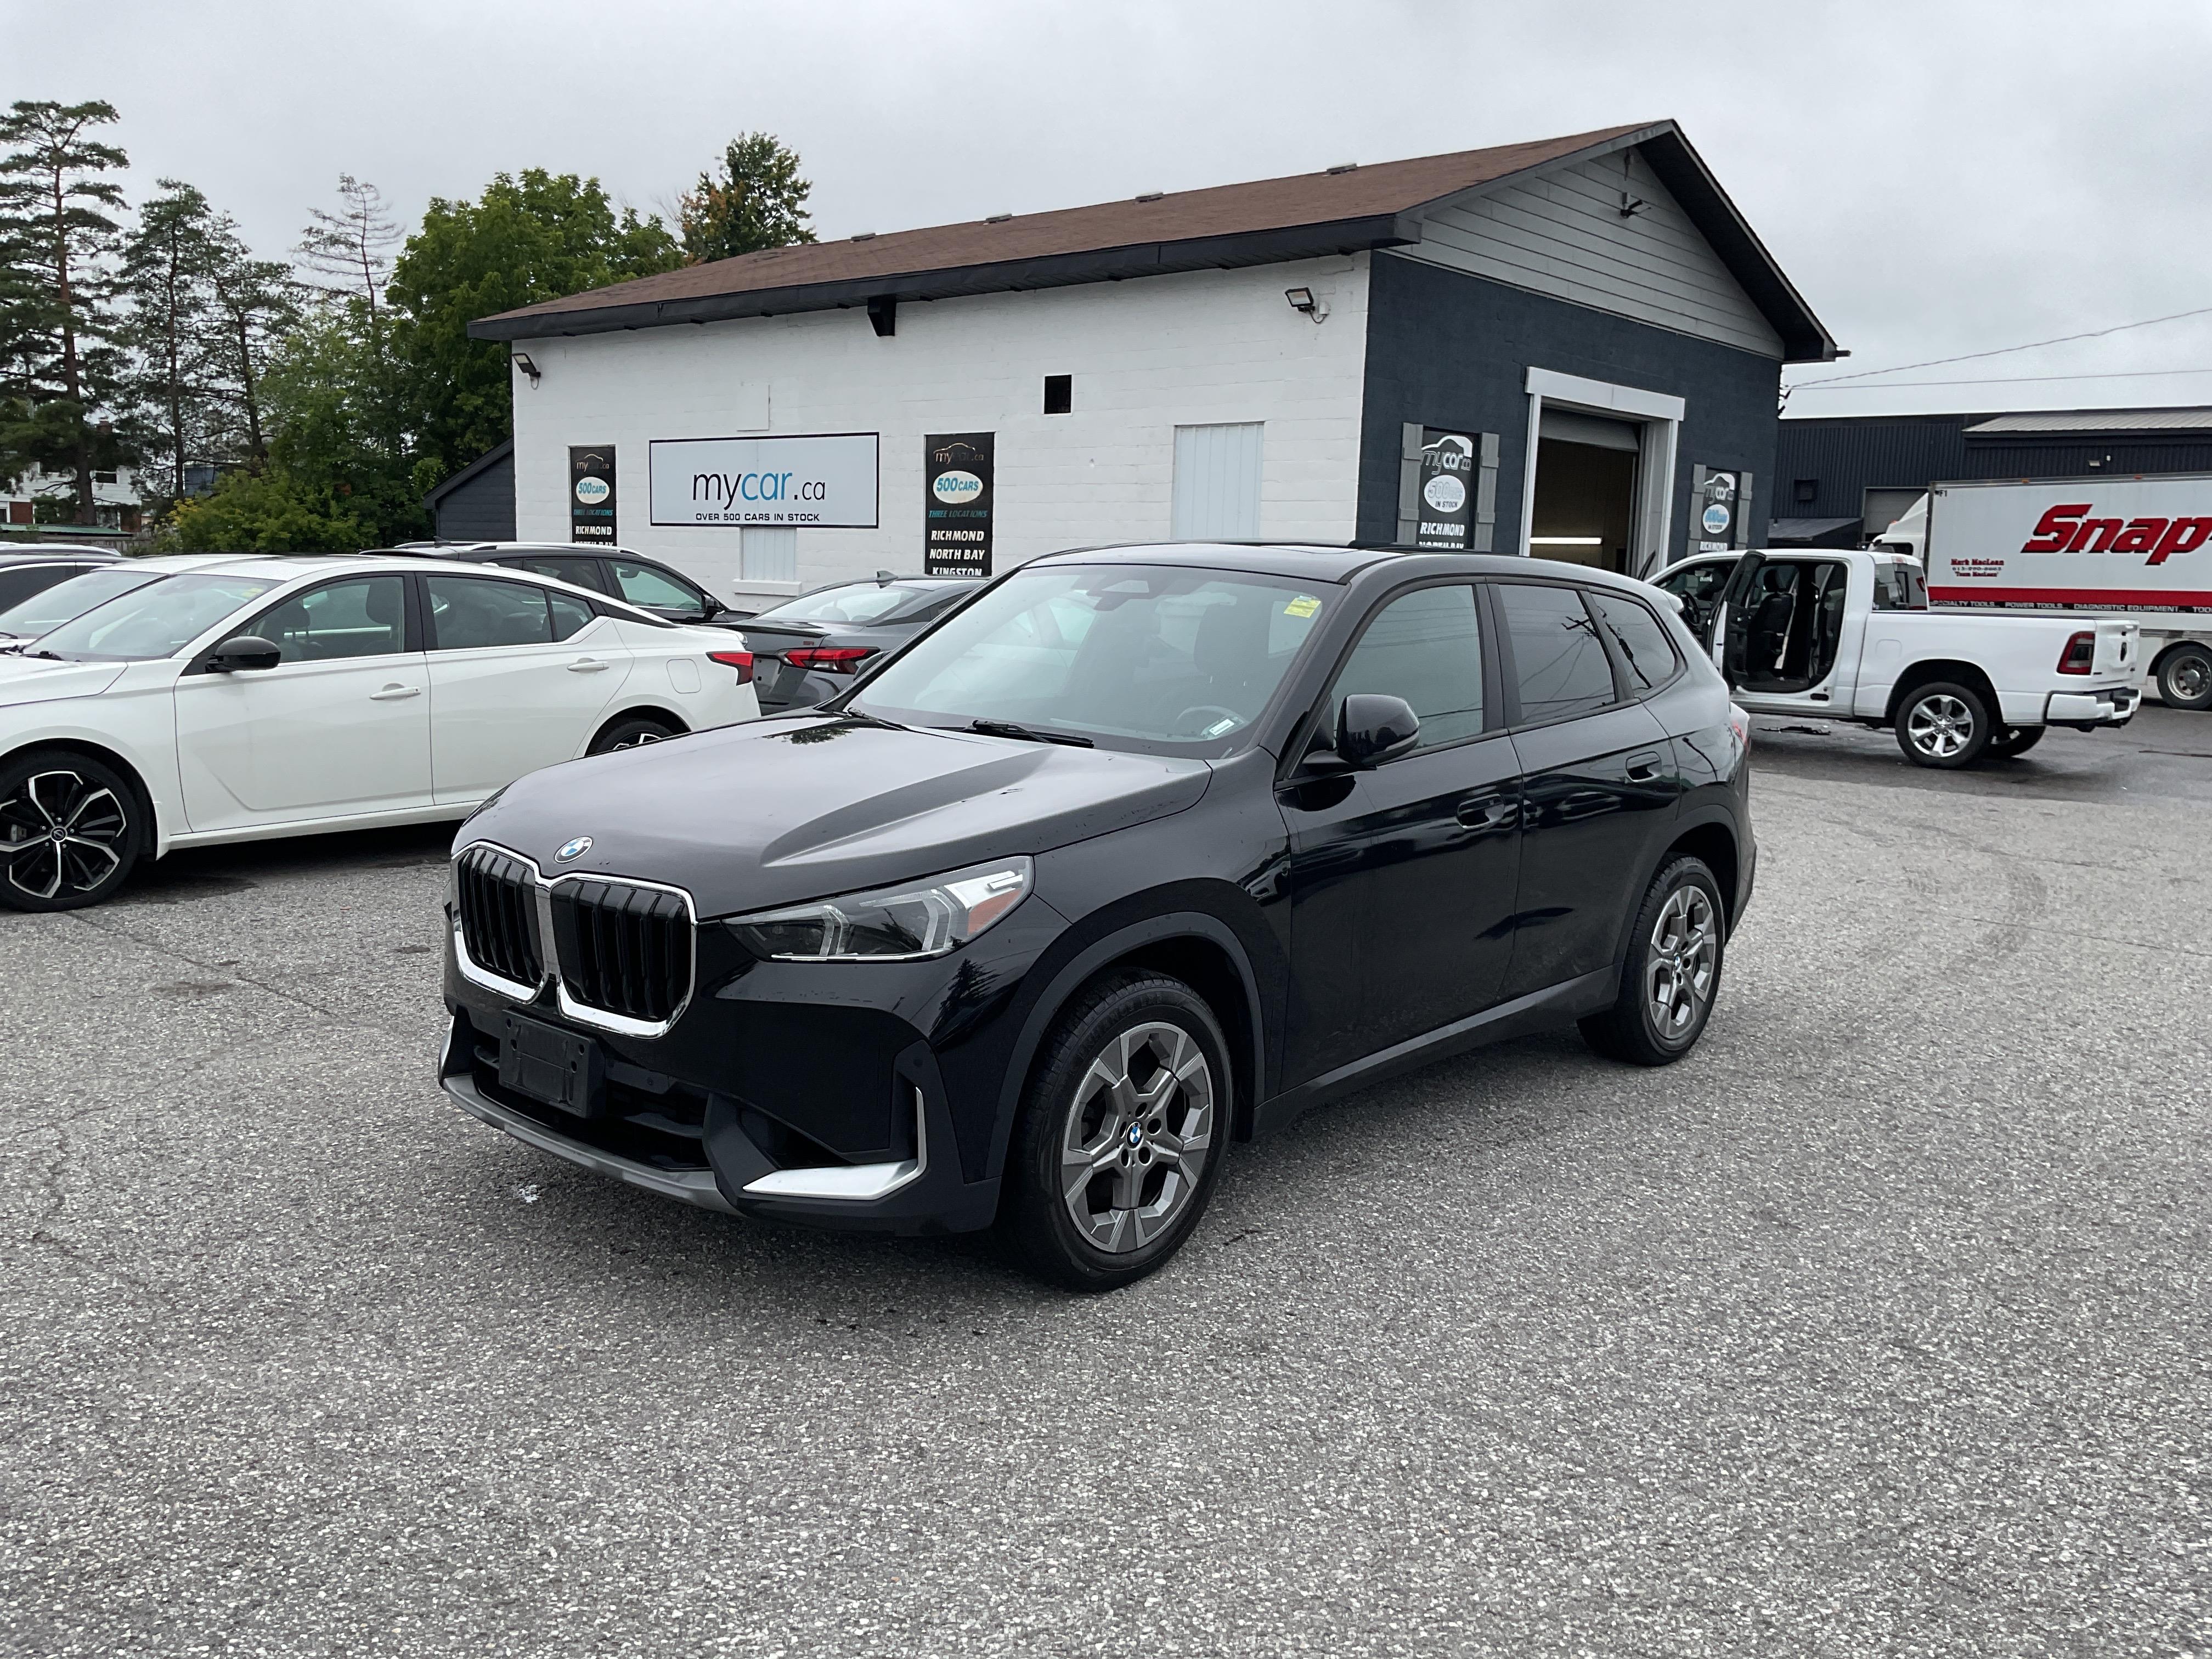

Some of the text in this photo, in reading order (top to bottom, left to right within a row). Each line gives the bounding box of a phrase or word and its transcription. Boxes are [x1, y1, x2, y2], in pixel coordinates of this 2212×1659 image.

[693, 472, 826, 511] mycar.ca
[744, 513, 770, 521] CARS
[774, 513, 783, 521] IN
[575, 526, 612, 535] RICHMOND
[1420, 522, 1465, 537] RICHMOND
[931, 530, 985, 541] RICHMOND
[929, 549, 985, 560] NORTH BAY
[932, 567, 983, 577] KINGSTON
